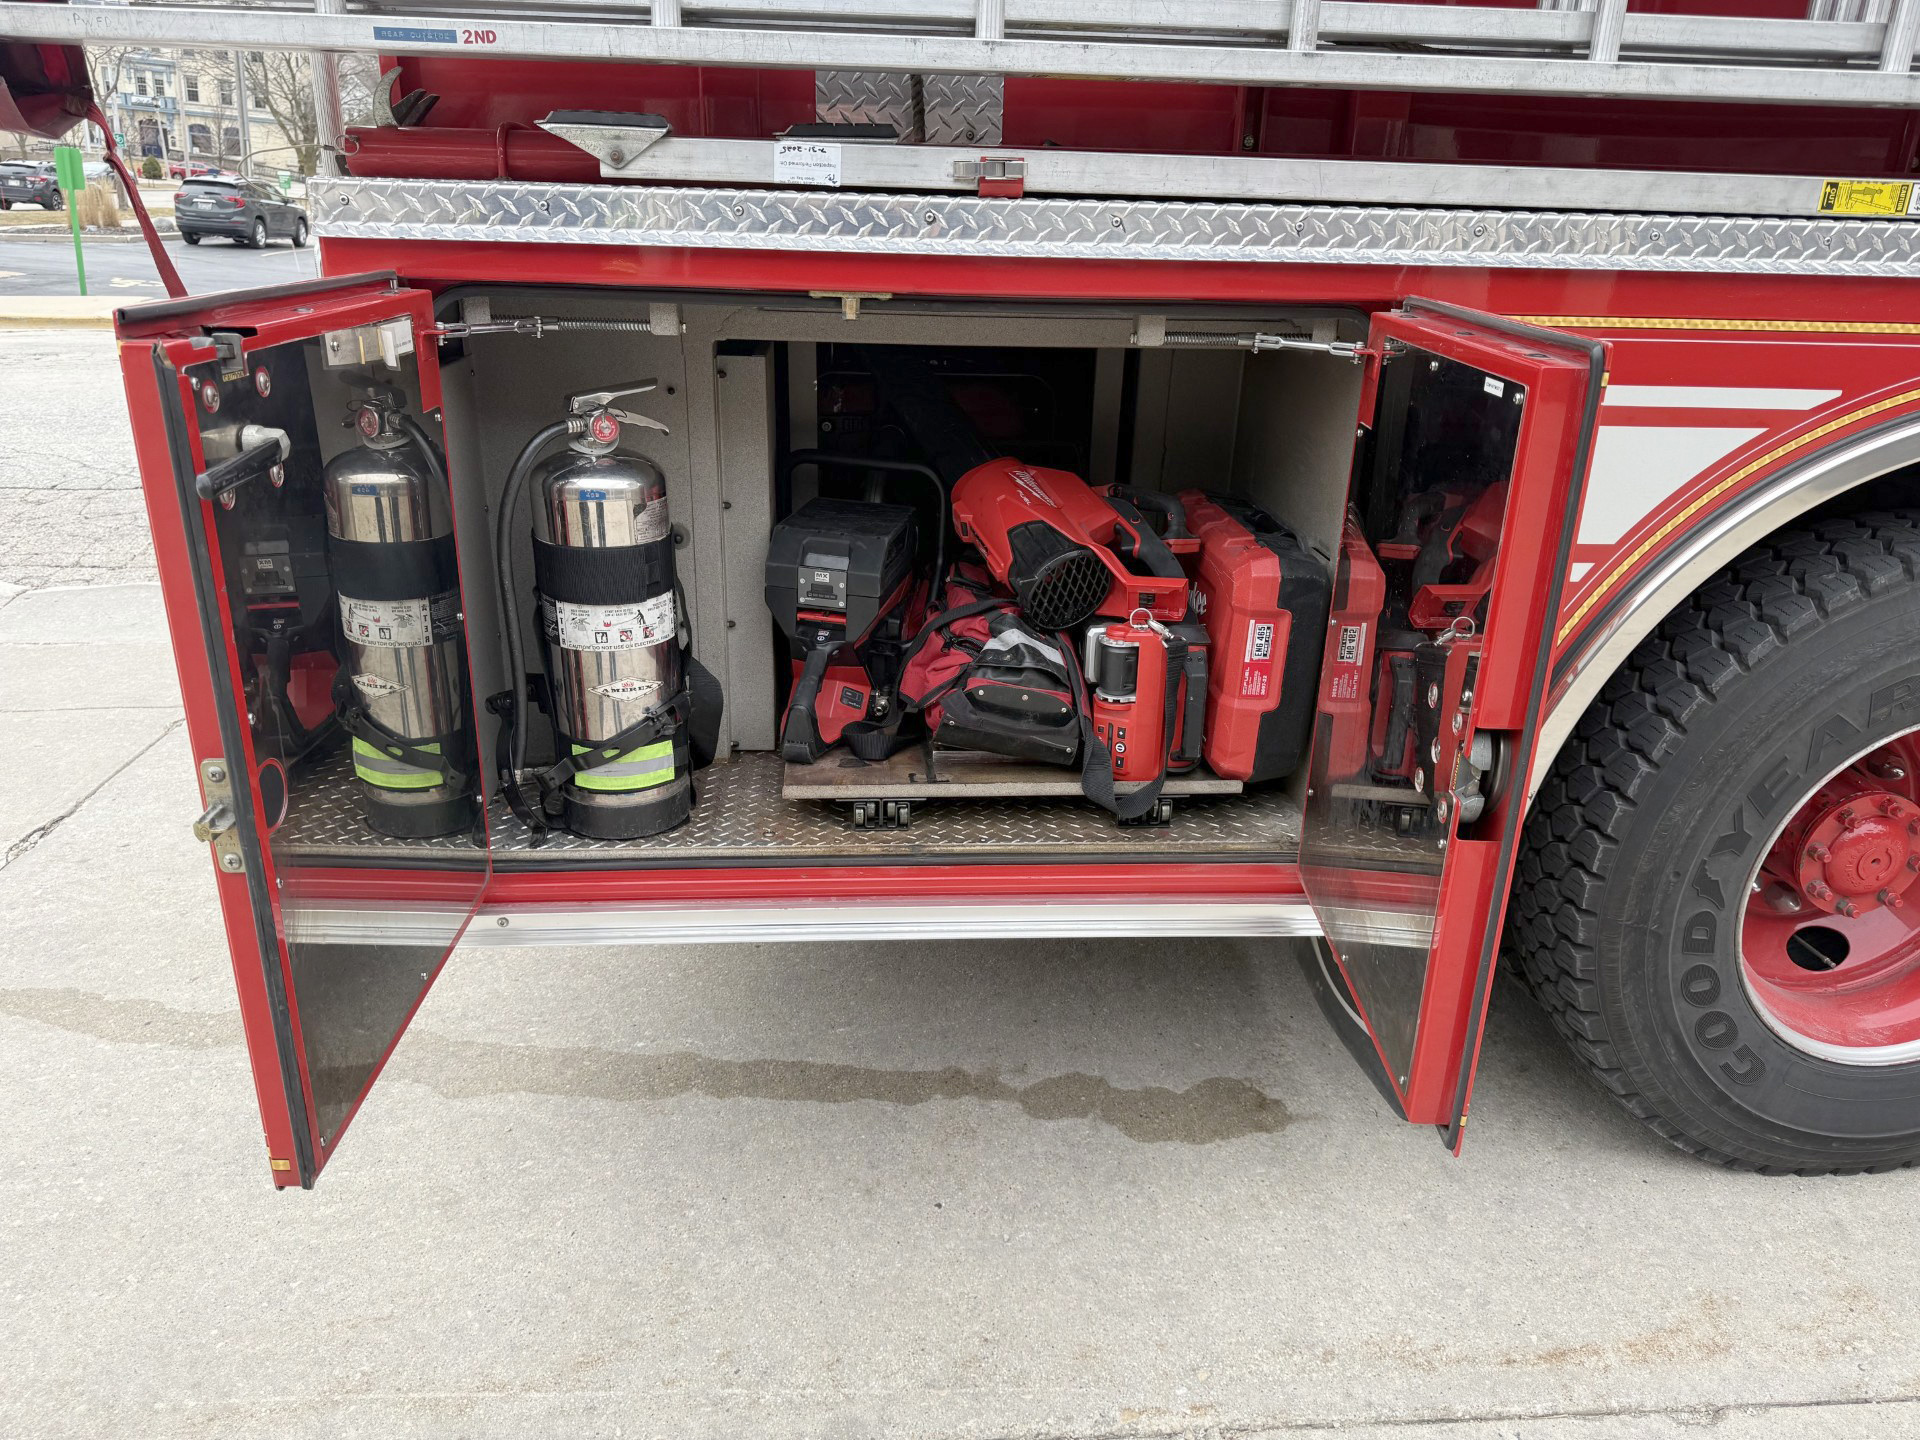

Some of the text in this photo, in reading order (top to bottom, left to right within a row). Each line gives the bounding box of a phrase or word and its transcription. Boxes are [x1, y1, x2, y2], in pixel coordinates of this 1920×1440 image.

[462, 29, 497, 44] 2ND
[1828, 188, 1837, 205] OUT
[1897, 185, 1908, 212] CAUTION
[1254, 626, 1266, 657] ENG 465
[602, 685, 654, 694] AMEREX
[1680, 674, 1920, 1086] GOODYEAR
